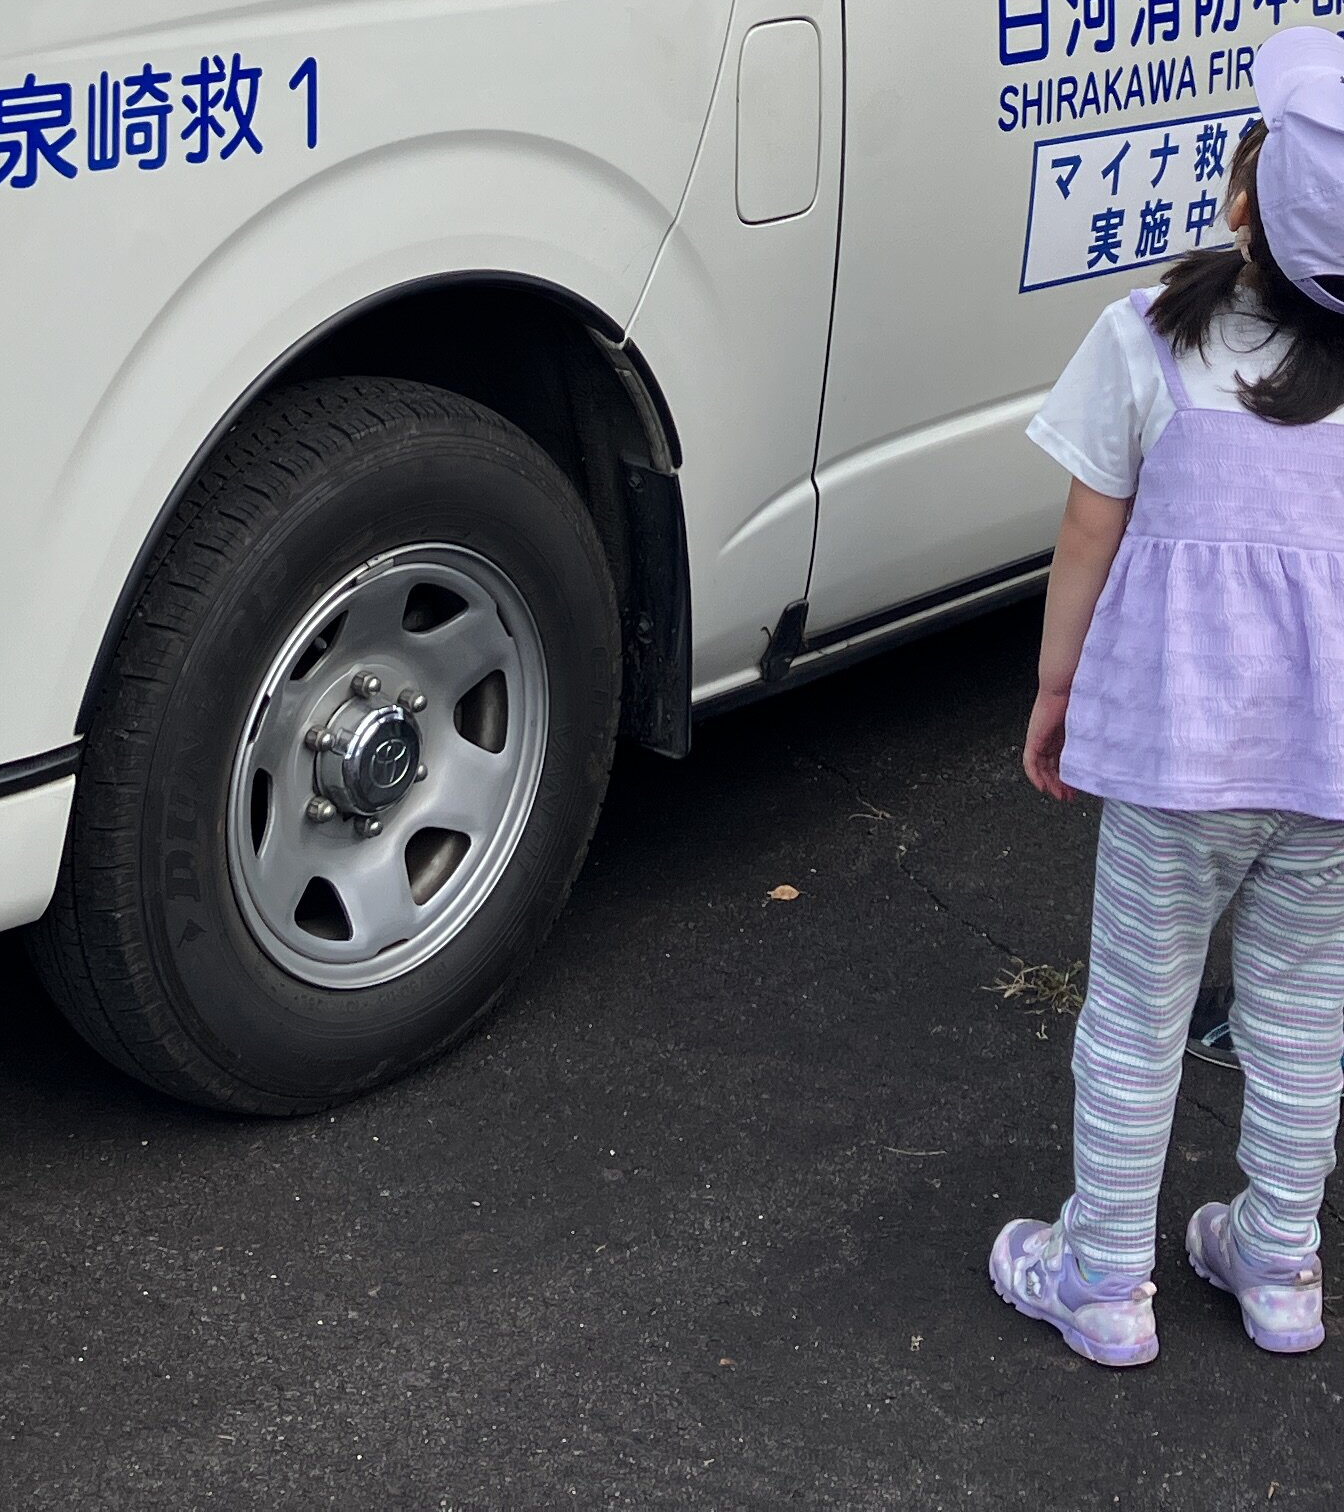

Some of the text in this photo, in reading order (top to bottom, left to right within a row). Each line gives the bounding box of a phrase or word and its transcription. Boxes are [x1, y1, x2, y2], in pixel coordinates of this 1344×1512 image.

[997, 44, 1263, 132] SHIRAKAWA FIR
[1051, 117, 1263, 200] マイナ救
[1086, 189, 1218, 270] 実施中
